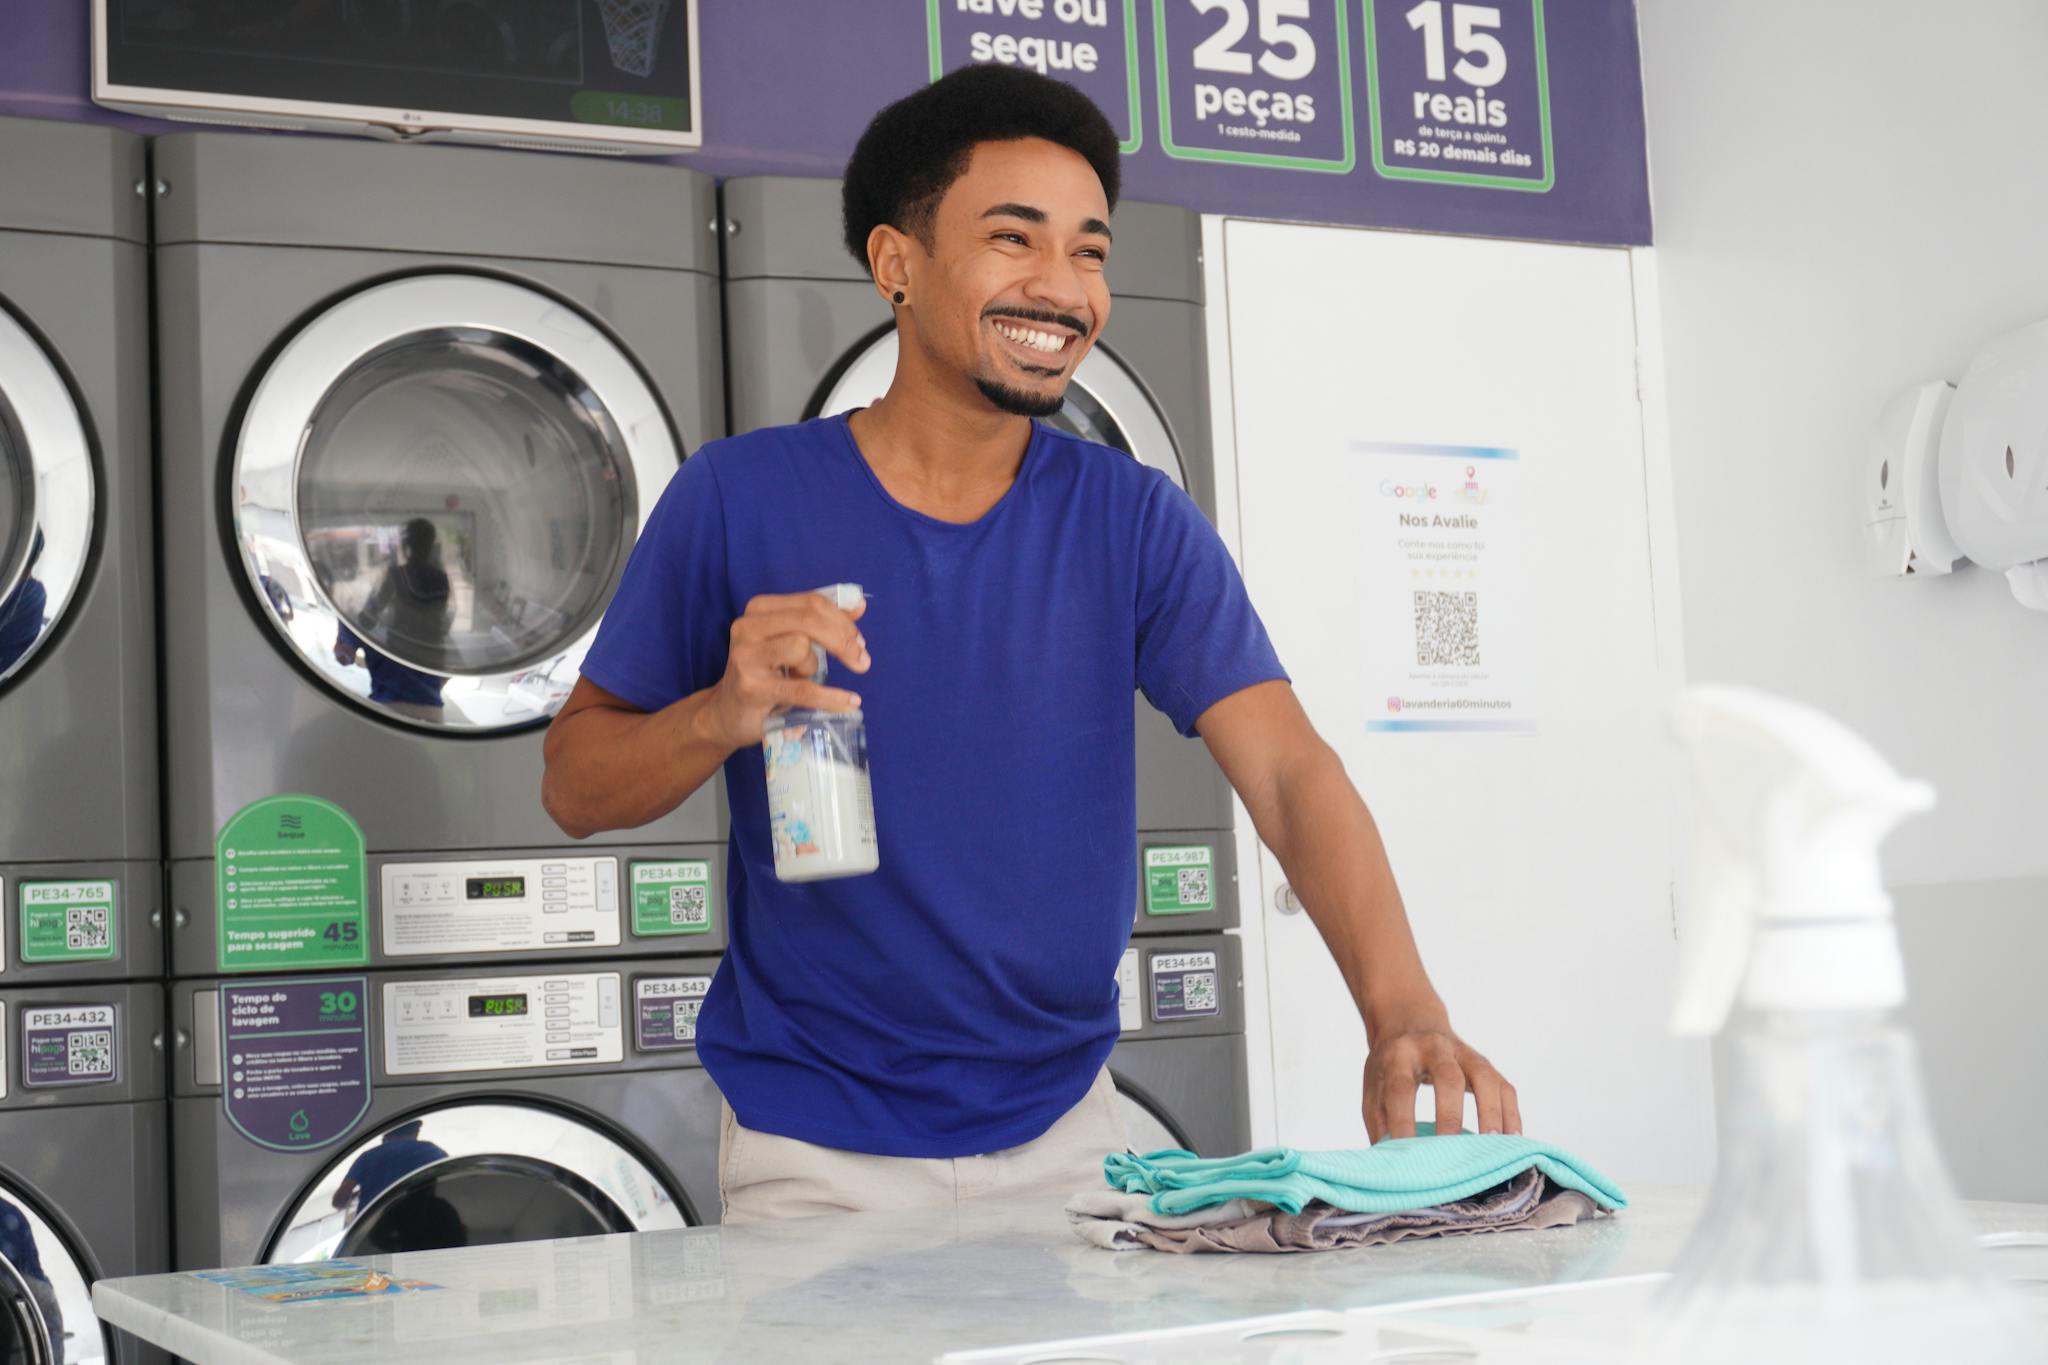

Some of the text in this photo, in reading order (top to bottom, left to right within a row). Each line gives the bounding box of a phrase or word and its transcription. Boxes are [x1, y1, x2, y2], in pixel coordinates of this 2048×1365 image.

[957, 0, 1107, 26] ave ou
[1189, 0, 1316, 80] 25
[1405, 0, 1507, 87] 15
[970, 31, 1099, 75] seque
[1195, 83, 1316, 127] peças
[1413, 87, 1507, 127] reais
[1218, 123, 1302, 142] 1 cesto-medida
[1418, 125, 1508, 145] de terça a quinta
[1393, 139, 1532, 167] R$ 20 demais dias
[1379, 479, 1438, 504] Google
[1399, 512, 1478, 529] Nos Avalie
[1402, 698, 1512, 710] lavanderia60minutos
[1151, 851, 1205, 863] PE34-987
[640, 867, 702, 880] PE34-876
[31, 887, 104, 901] PE34-765
[227, 928, 316, 942] Tempo sugerido
[323, 921, 358, 942] 45
[227, 940, 304, 953] para secagem
[1157, 956, 1211, 969] PE34-654
[643, 981, 706, 995] PE34-543
[231, 992, 287, 1005] Tempo do
[320, 991, 357, 1014] 30
[232, 1004, 275, 1016] ciclo de
[33, 1011, 106, 1026] PE34-432
[232, 1016, 280, 1027] lavagem
[320, 1014, 356, 1022] minutos
[288, 1132, 311, 1141] Lave
